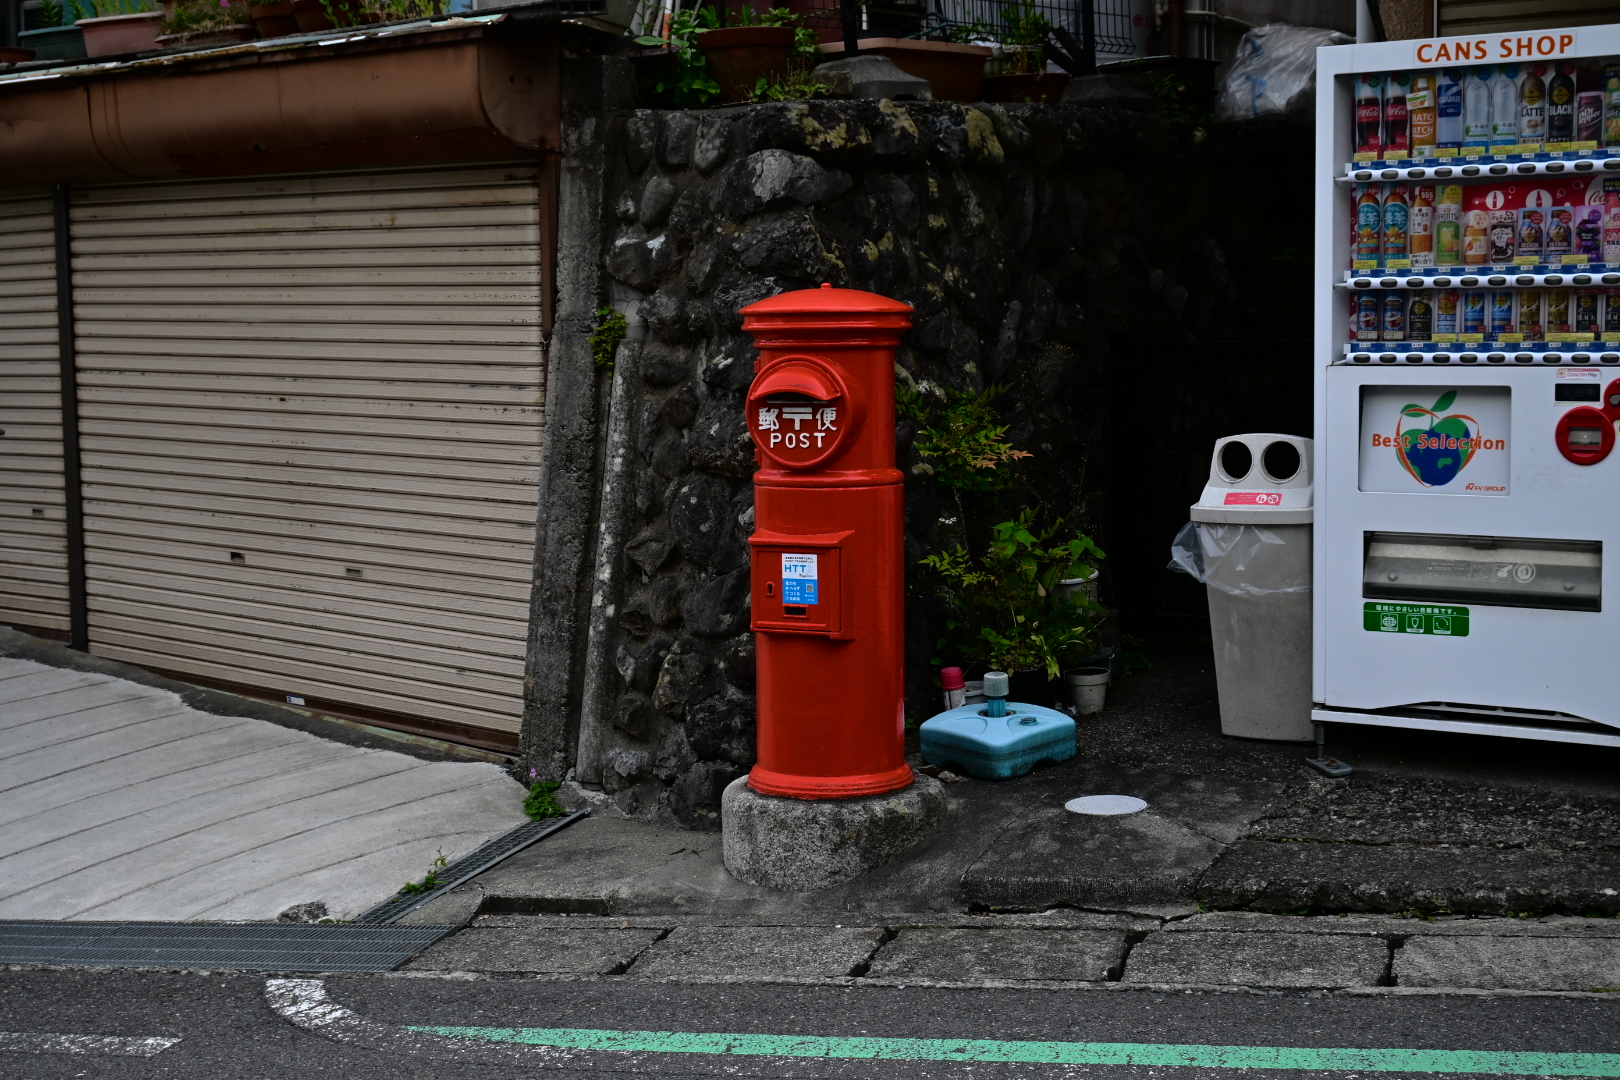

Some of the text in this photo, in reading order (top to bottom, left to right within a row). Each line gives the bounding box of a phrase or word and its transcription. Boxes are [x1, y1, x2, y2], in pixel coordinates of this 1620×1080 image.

[1416, 34, 1573, 63] CANS SHOP
[1521, 108, 1545, 117] LATTE
[1549, 105, 1573, 115] BLACK
[1358, 212, 1379, 224] 麦茶
[1384, 211, 1407, 224] 麦茶
[770, 433, 826, 448] POST
[1372, 433, 1505, 450] Best Selection
[784, 564, 807, 572] HTT
